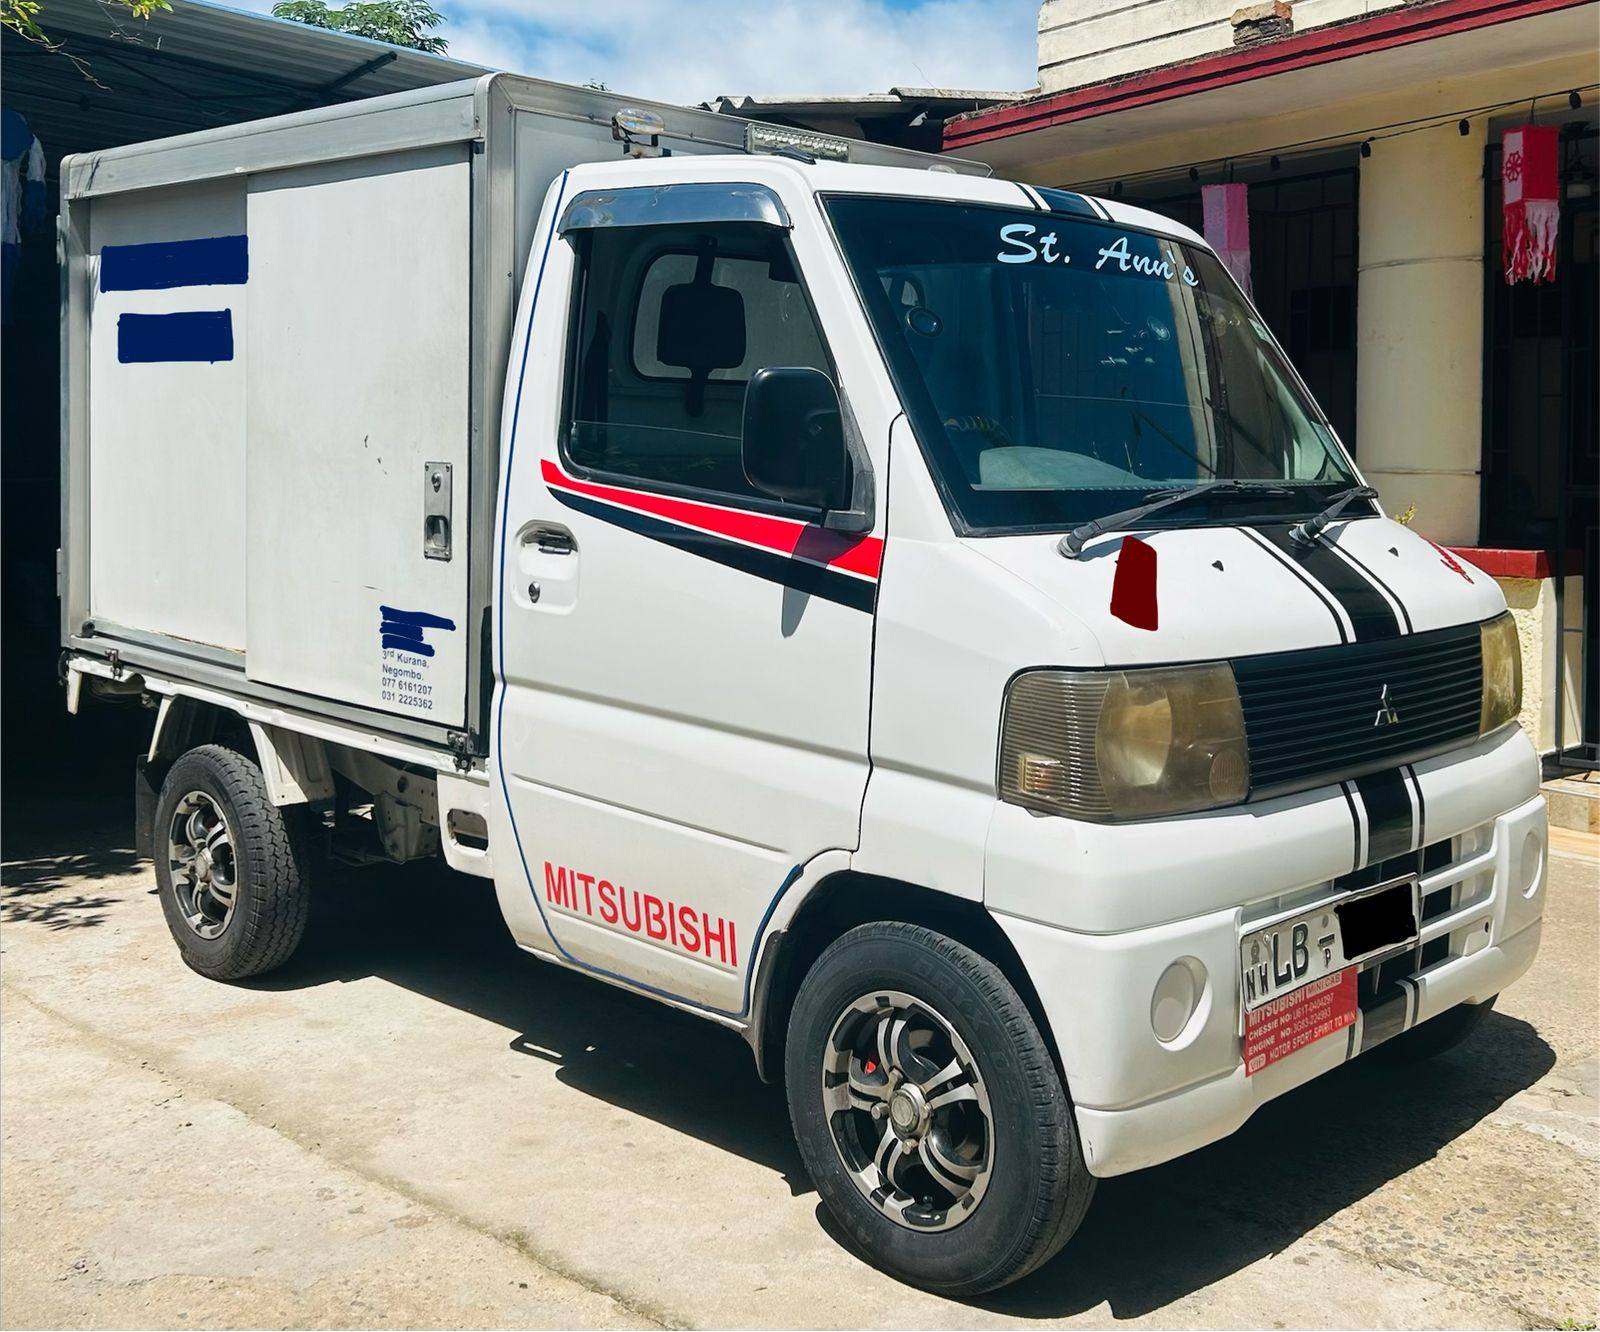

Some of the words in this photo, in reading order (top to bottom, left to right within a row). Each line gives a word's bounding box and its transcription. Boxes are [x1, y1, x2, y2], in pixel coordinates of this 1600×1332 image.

[996, 223, 1070, 264] St.
[1095, 236, 1199, 287] Ann's
[382, 650, 395, 660] 3rd
[381, 677, 396, 687] 077
[398, 680, 433, 696] 6161207
[381, 690, 396, 701] 031
[398, 693, 433, 710] 2225362
[544, 860, 738, 968] MITSUBISHI
[1248, 986, 1306, 1028] MITSUBISHI
[1248, 1035, 1276, 1056] ENGINE
[1292, 1030, 1312, 1049] SPORT
[1313, 1020, 1334, 1039] SPIRIT
[1334, 1016, 1343, 1028] TO
